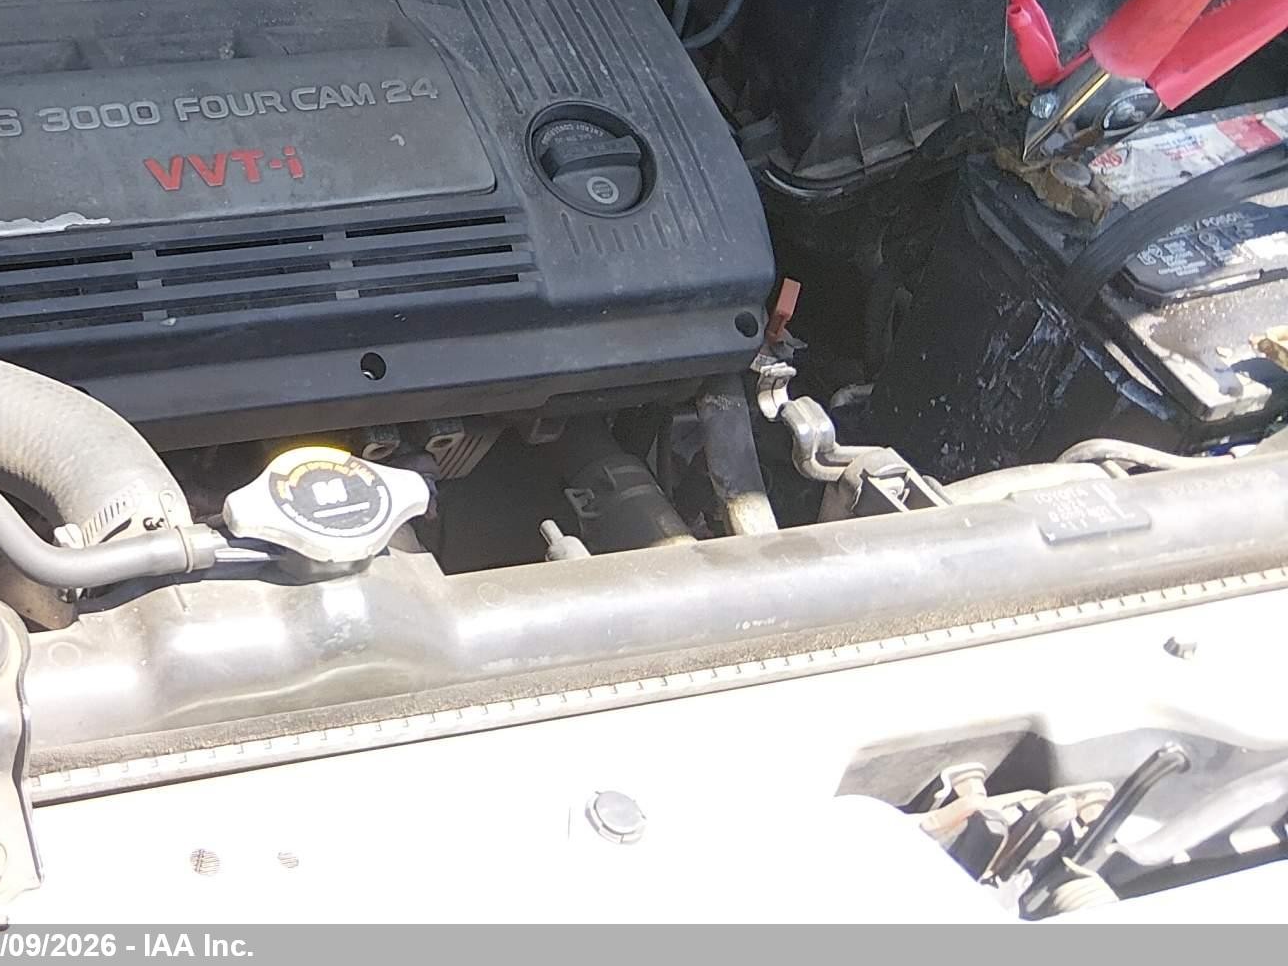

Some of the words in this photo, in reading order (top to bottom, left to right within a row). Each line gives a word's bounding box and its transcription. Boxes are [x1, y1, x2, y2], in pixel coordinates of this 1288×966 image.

[38, 98, 162, 134] 3000
[174, 88, 288, 122] FOUR
[291, 81, 377, 112] CAM
[381, 77, 439, 105] 24
[144, 145, 305, 192] VVT-i
